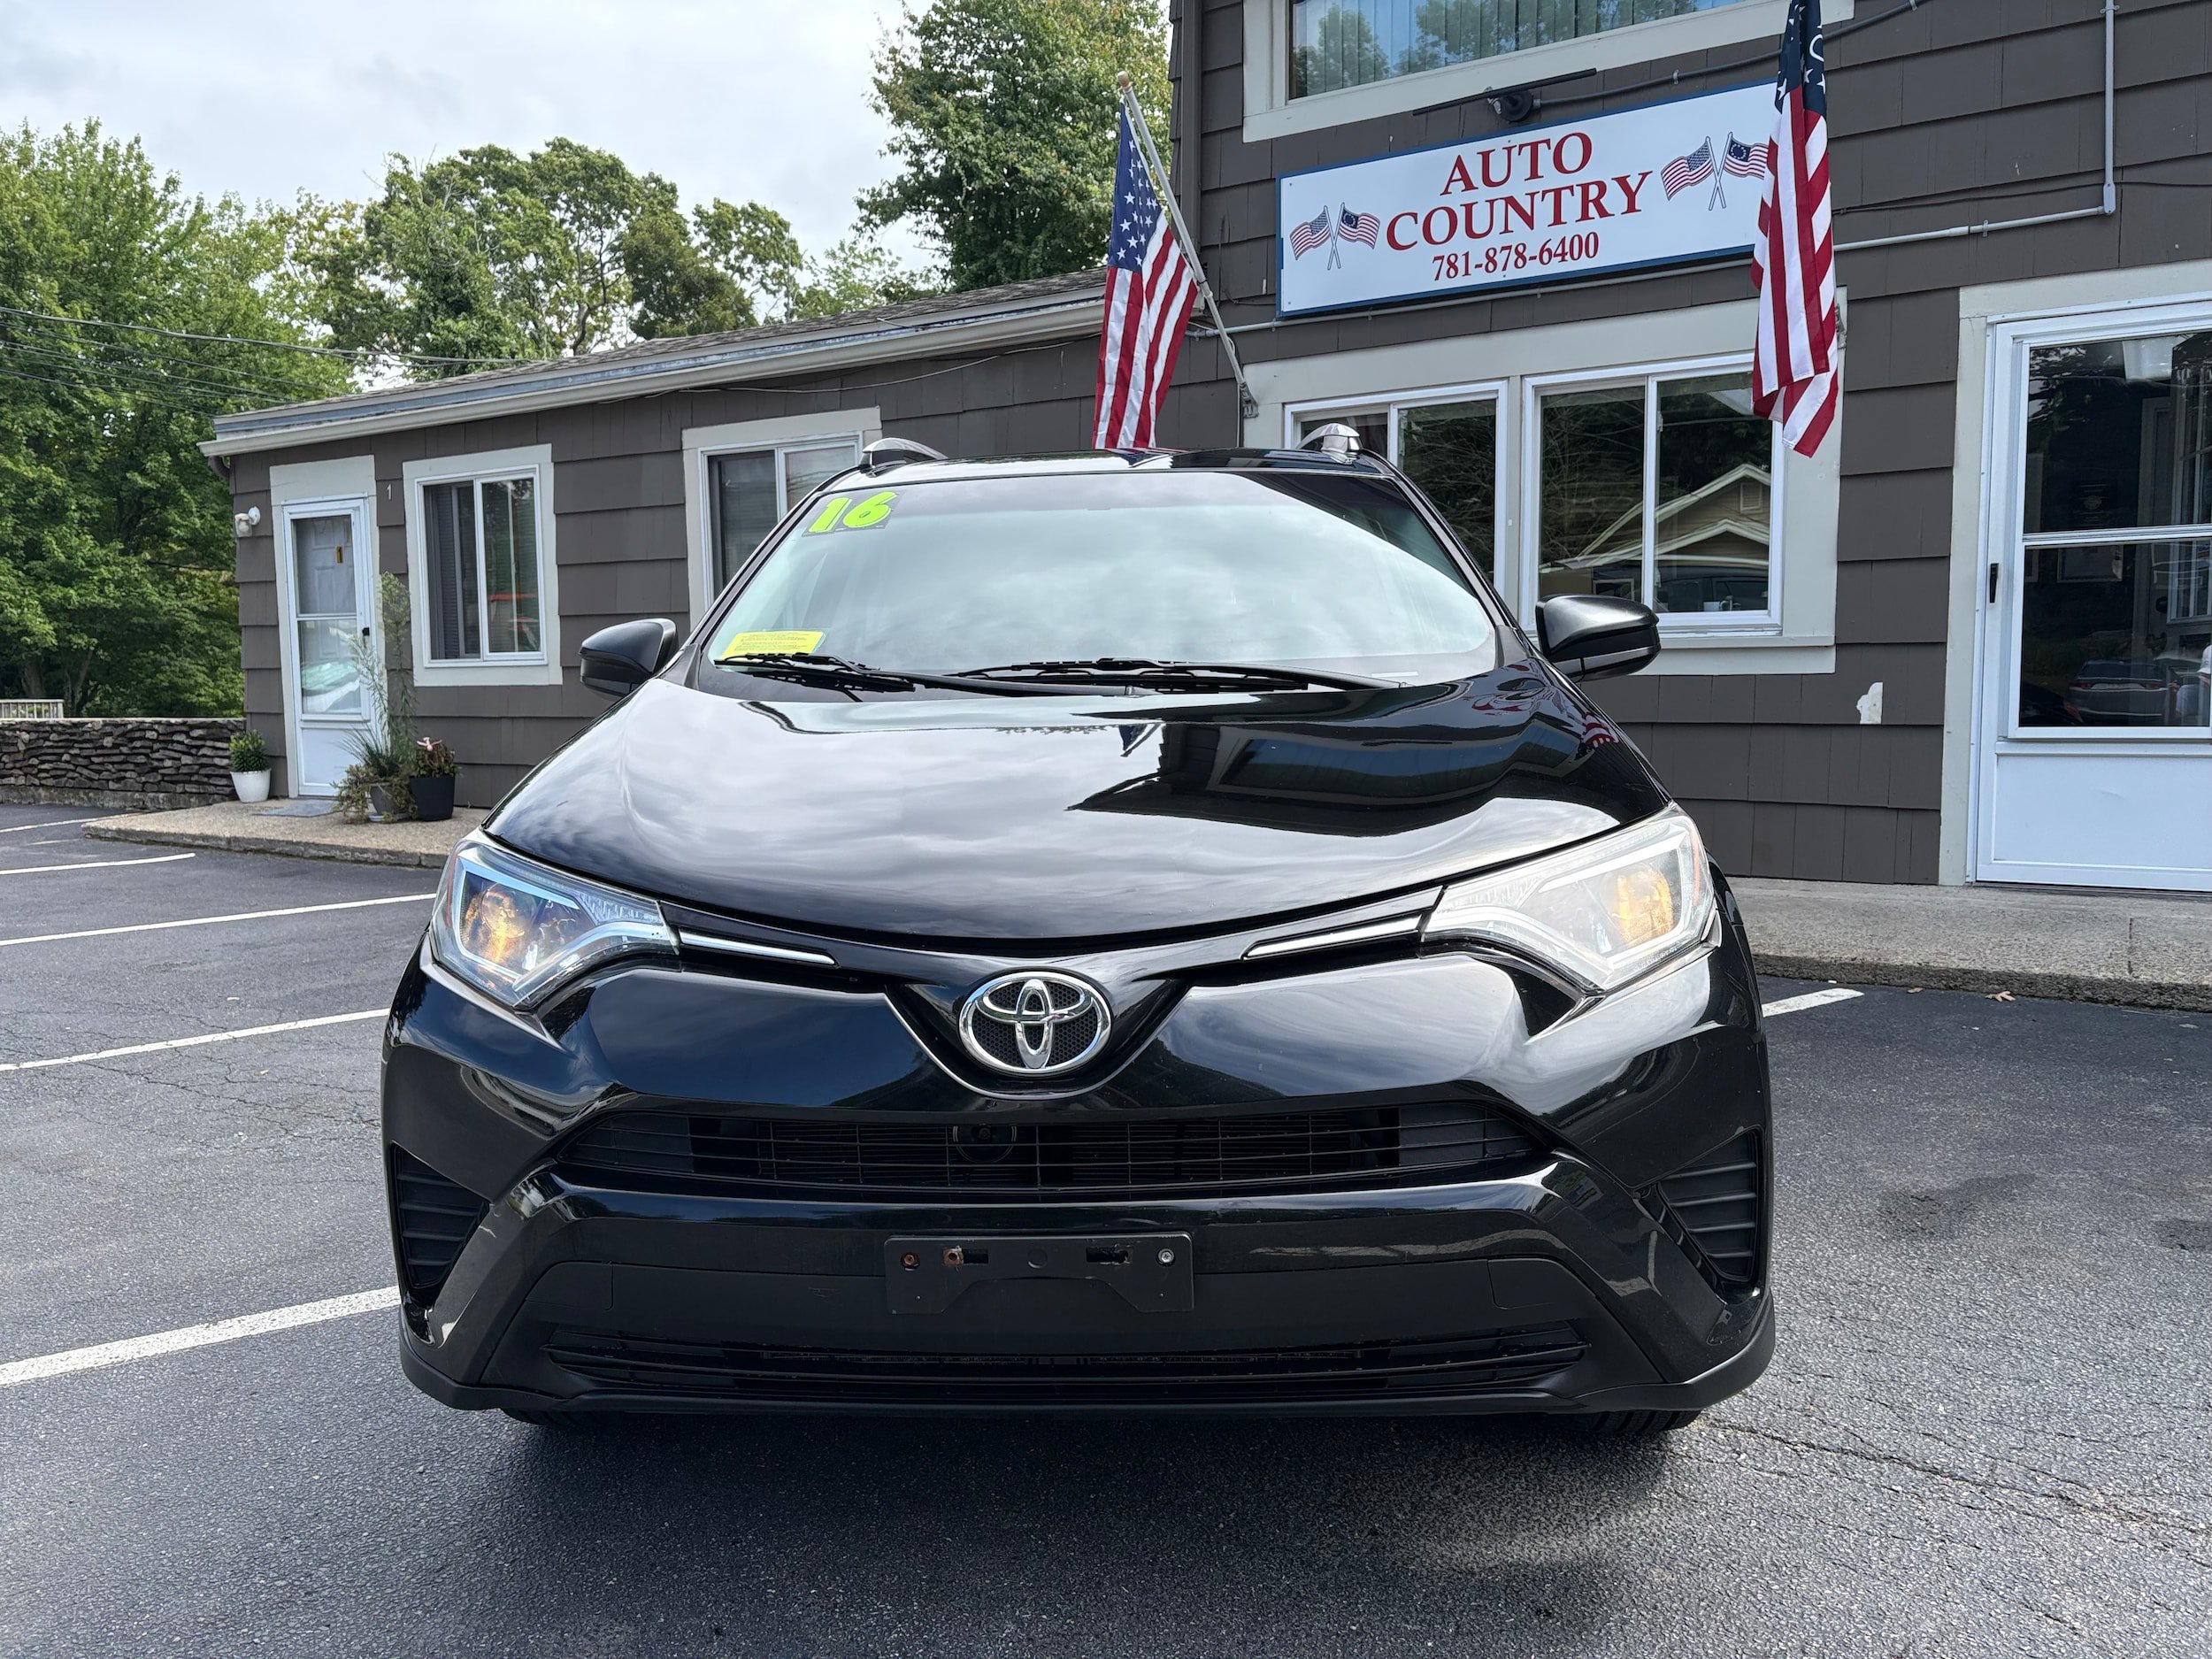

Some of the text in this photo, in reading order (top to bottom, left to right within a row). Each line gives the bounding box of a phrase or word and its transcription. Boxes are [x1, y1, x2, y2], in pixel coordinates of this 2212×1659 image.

[1440, 131, 1594, 196] AUTO
[1386, 170, 1654, 251] COUNTRY
[1432, 231, 1600, 281] 781-878-6400
[808, 491, 896, 533] 16
